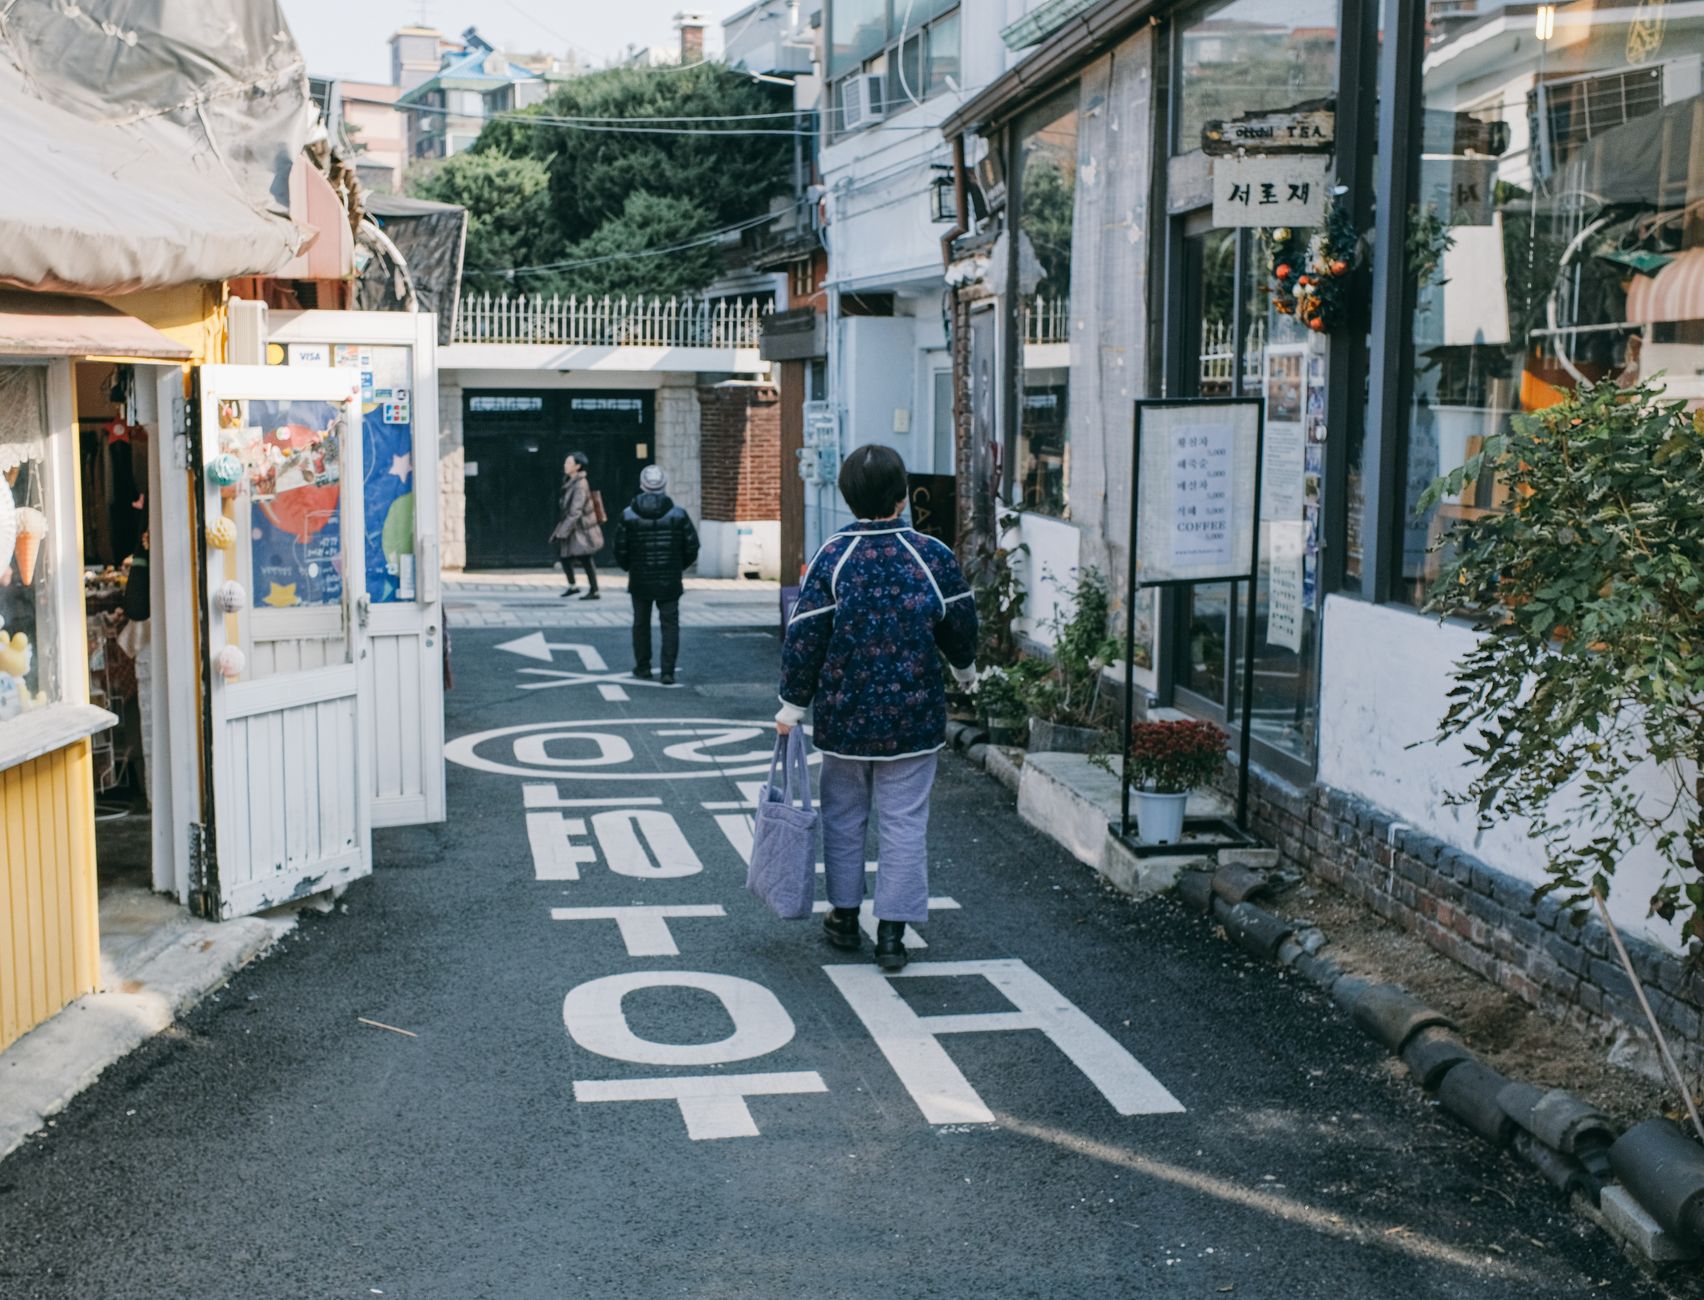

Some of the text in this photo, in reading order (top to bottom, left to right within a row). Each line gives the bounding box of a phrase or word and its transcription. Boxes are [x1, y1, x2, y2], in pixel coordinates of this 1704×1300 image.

[1228, 182, 1310, 206] 서로재
[300, 352, 321, 362] VISA
[1177, 520, 1226, 532] COFFEE
